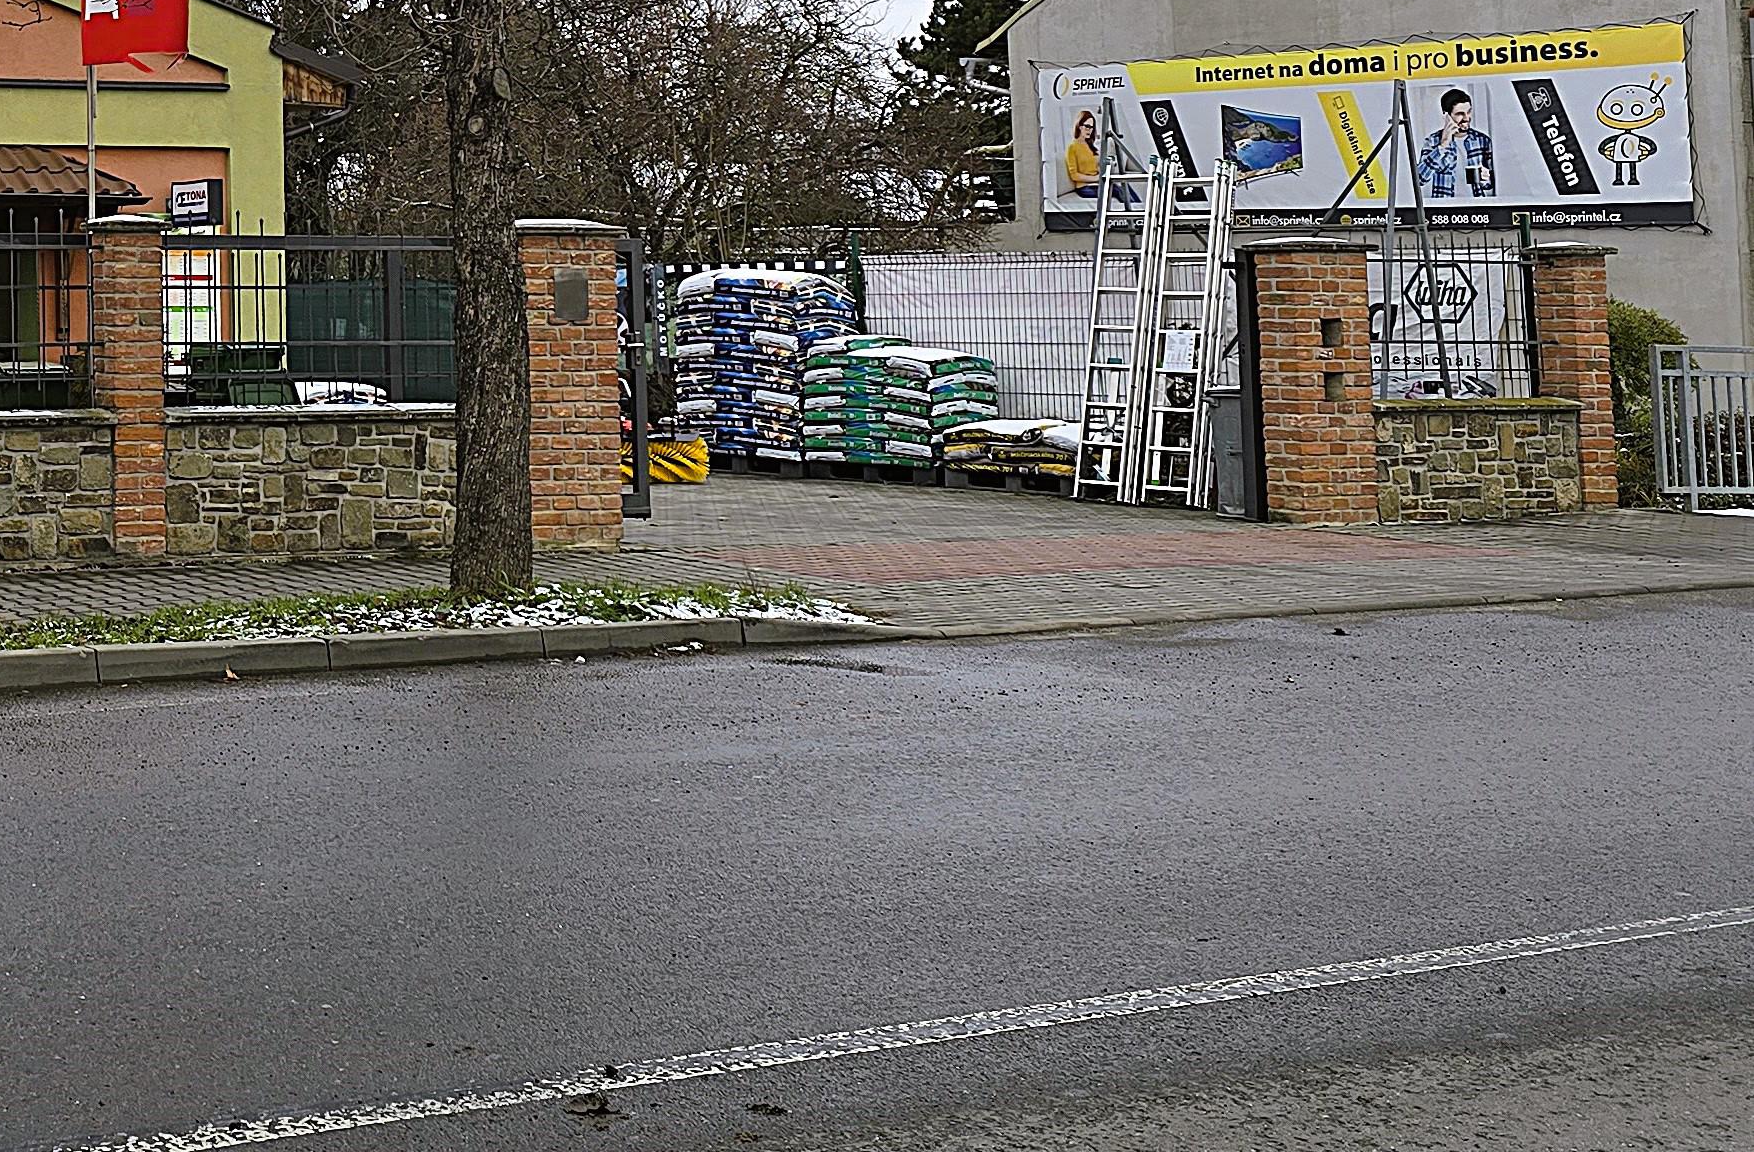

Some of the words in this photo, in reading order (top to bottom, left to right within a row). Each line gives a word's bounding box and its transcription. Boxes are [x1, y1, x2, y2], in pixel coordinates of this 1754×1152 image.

[1195, 64, 1274, 84] Internet
[1278, 63, 1304, 79] na
[1308, 52, 1386, 77] doma
[1393, 50, 1400, 72] i
[1406, 50, 1449, 76] pro
[1455, 39, 1600, 68] business.
[1160, 129, 1195, 196] Internt
[1541, 113, 1580, 188] Telefon
[1432, 215, 1450, 225] 588
[1451, 214, 1469, 224] 008
[1470, 214, 1490, 224] 008
[1531, 209, 1622, 226] info@sprintel.cz
